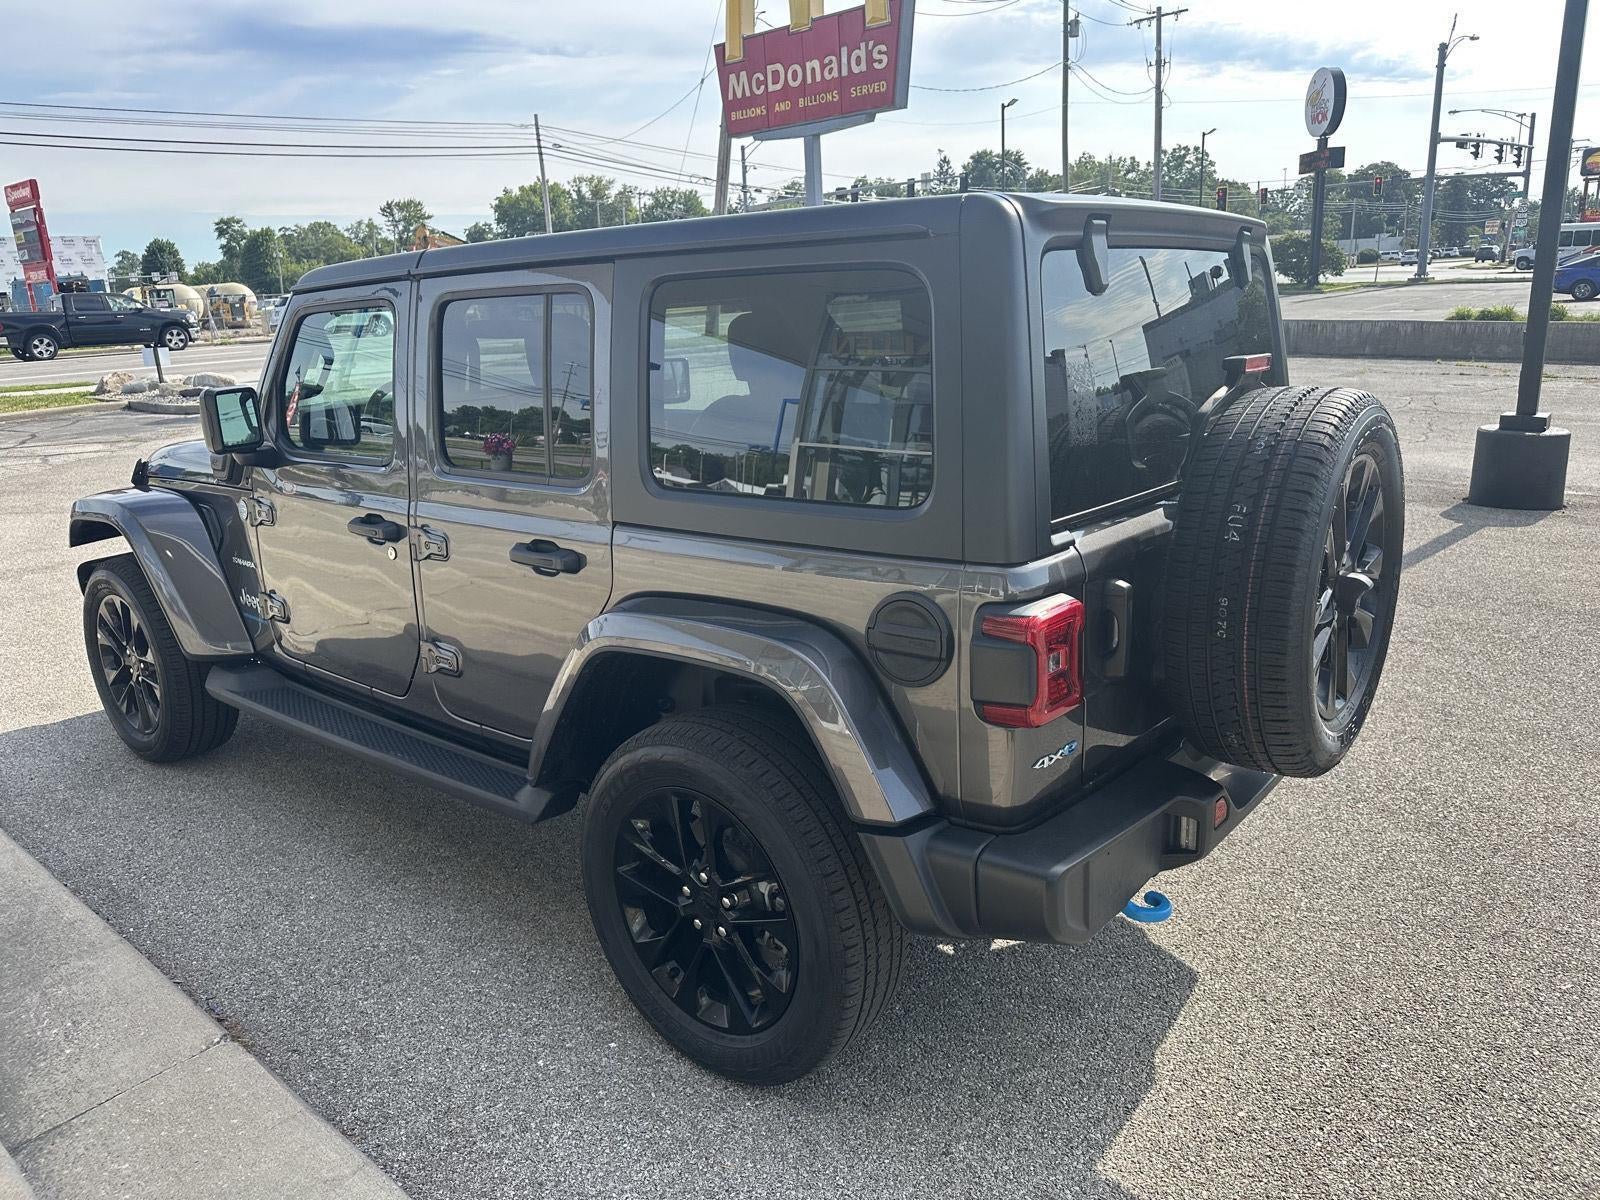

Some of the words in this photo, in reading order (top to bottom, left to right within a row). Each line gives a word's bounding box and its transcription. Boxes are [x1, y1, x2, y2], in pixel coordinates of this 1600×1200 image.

[728, 40, 888, 101] McDonald's
[731, 105, 767, 121] BILLIONS
[774, 100, 791, 113] AND
[798, 90, 839, 108] BILLIONS
[850, 80, 887, 98] SERVED
